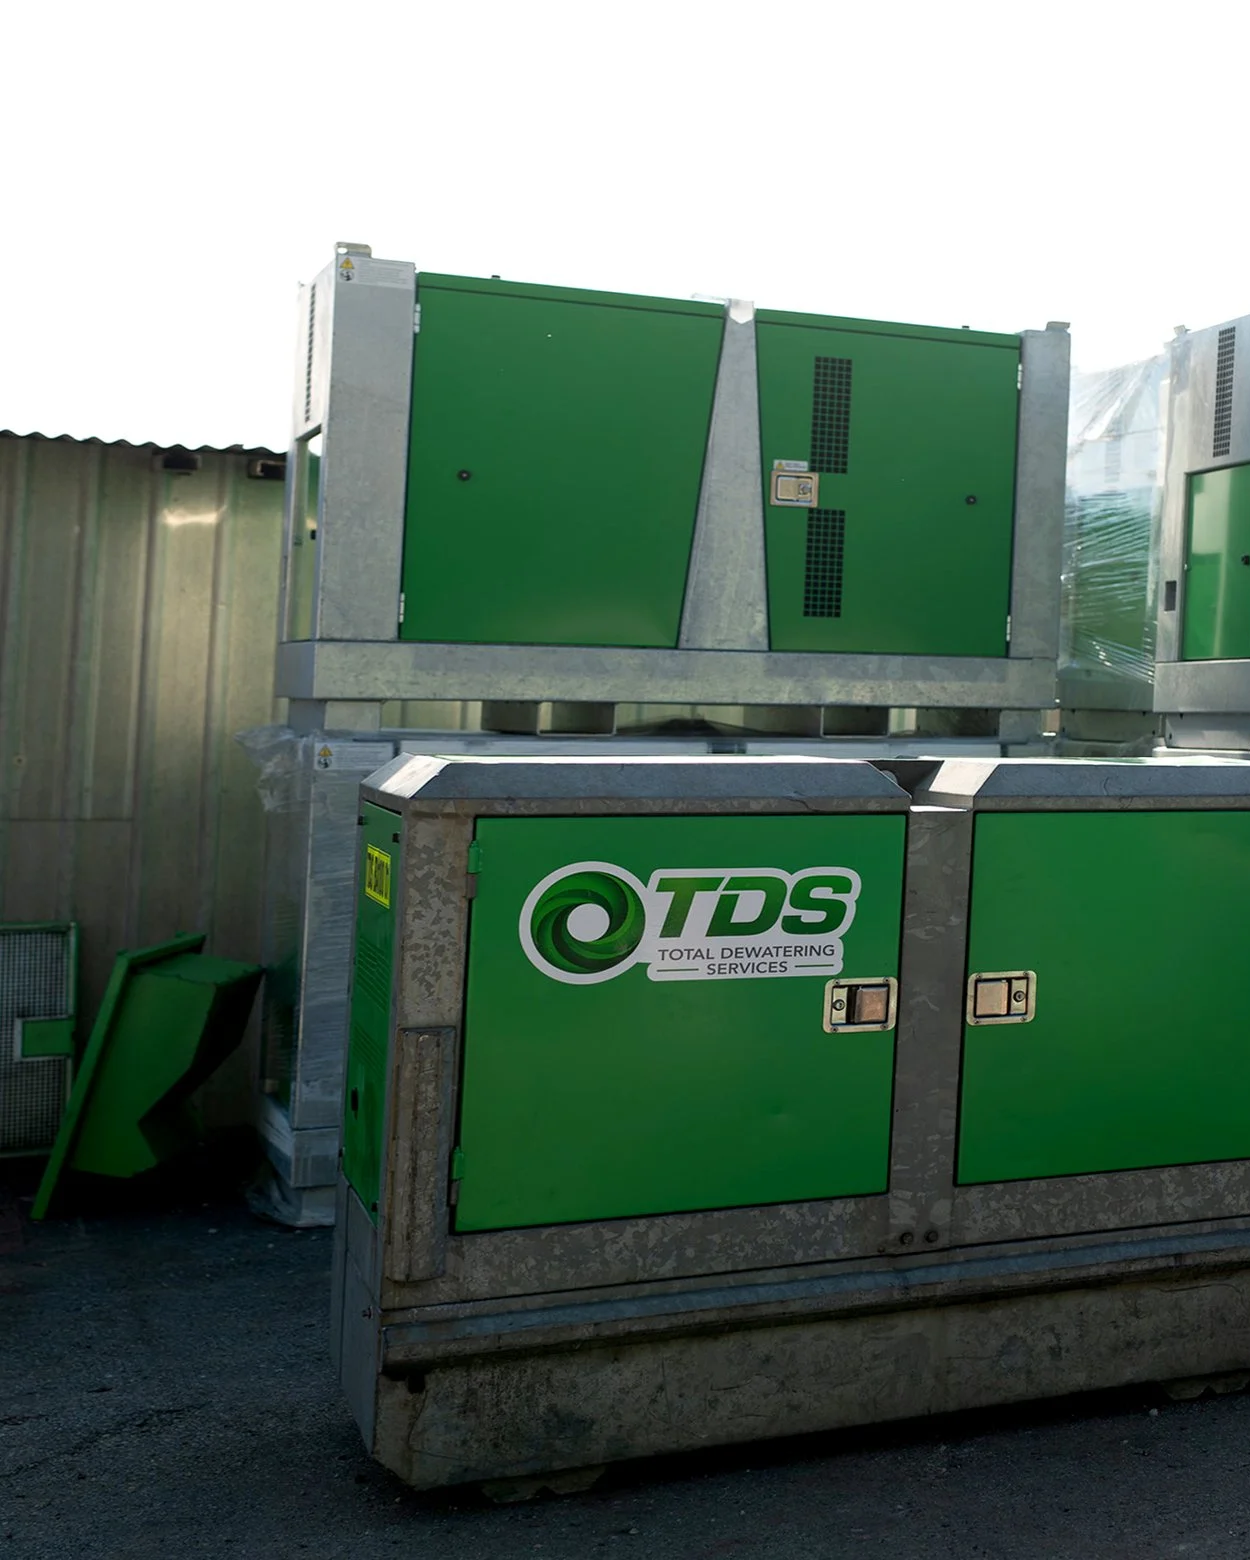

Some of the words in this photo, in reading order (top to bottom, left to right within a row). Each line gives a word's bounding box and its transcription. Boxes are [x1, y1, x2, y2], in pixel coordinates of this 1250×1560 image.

[656, 875, 852, 938] TDS
[657, 948, 714, 961] TOTAL
[720, 944, 835, 959] DEWATERING
[706, 961, 788, 975] SERVICES
